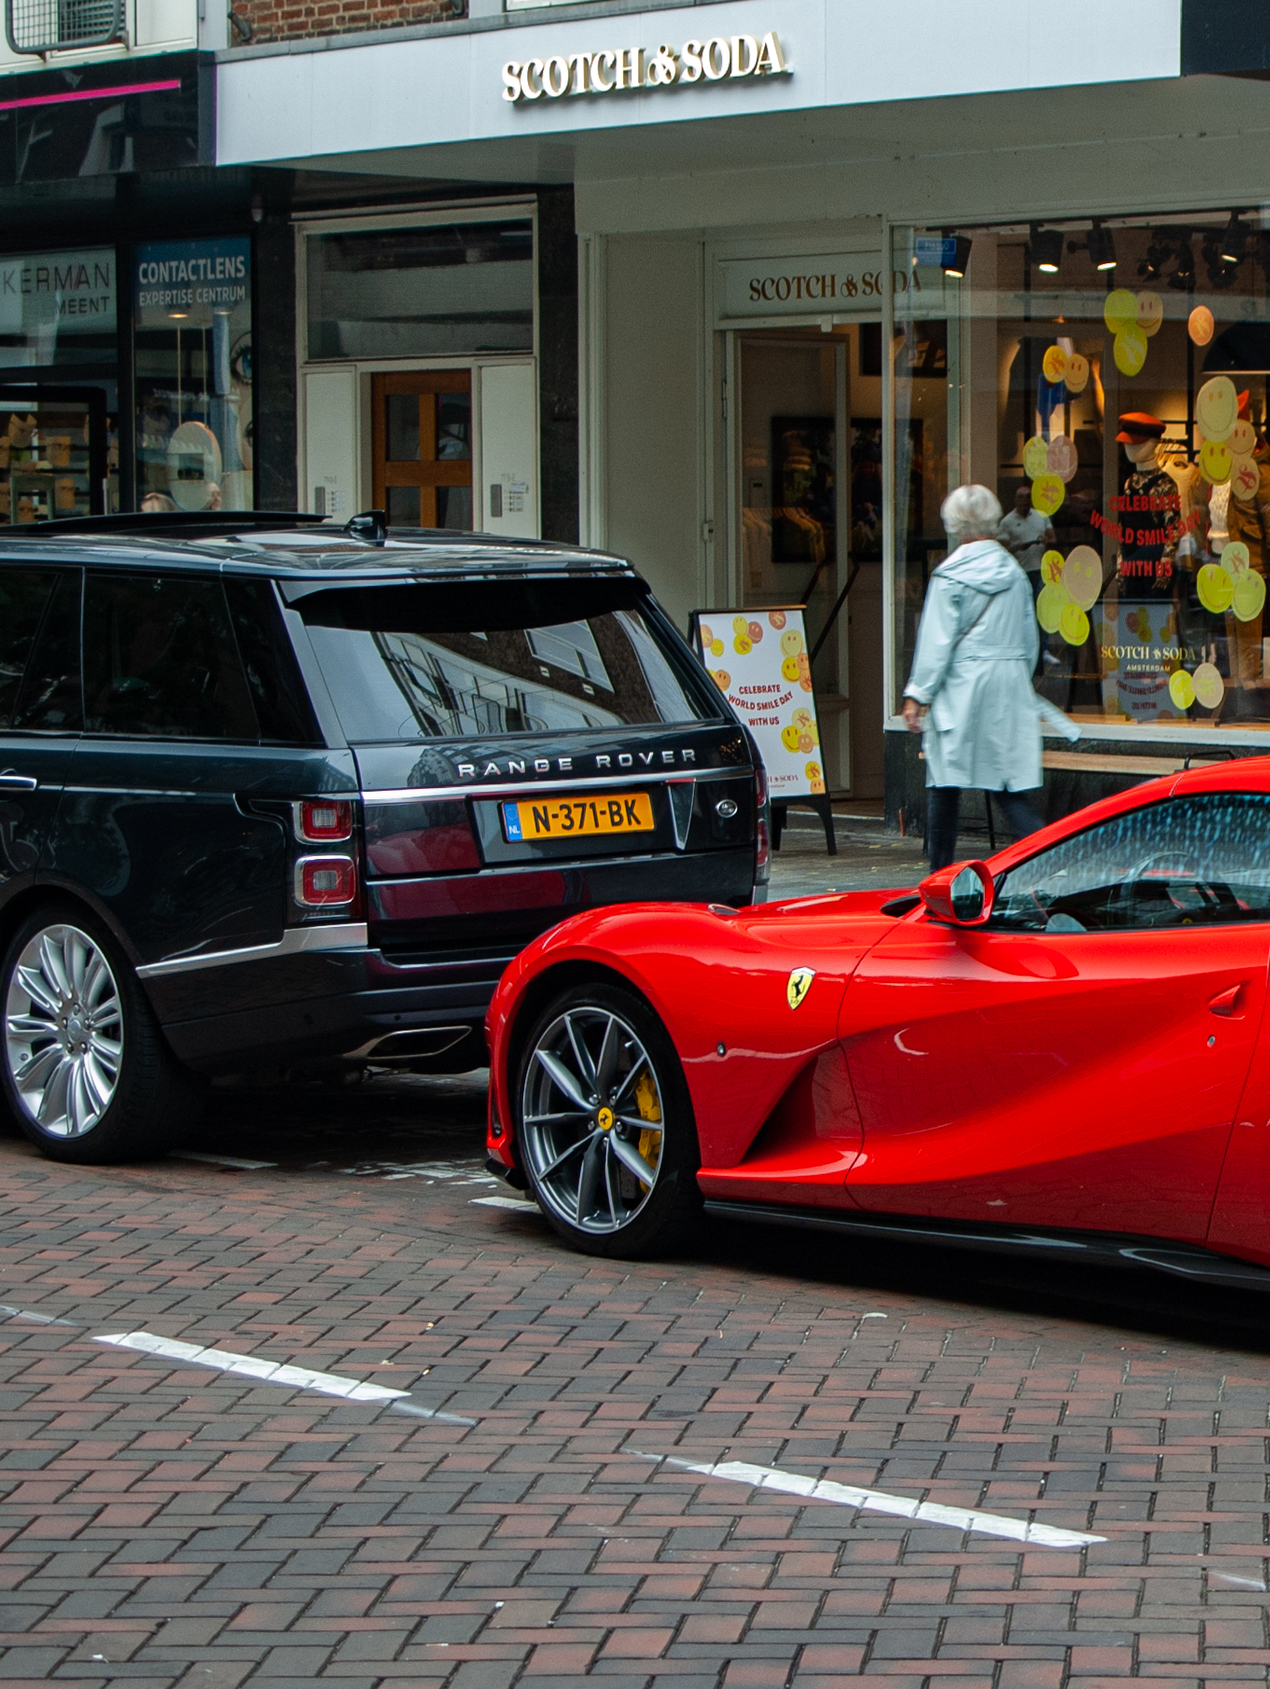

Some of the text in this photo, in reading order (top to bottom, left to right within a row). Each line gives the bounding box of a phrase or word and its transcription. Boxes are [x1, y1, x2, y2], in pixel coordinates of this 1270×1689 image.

[502, 31, 794, 102] SCOTCH & SODA
[138, 256, 246, 284] CONTACTLENS
[139, 286, 246, 306] EXPERTISE CENTRUM
[750, 273, 837, 302] SCOTCH
[840, 273, 859, 298] &
[1109, 494, 1181, 512] CELEBRATE
[1090, 510, 1201, 546] WORLD SMILE DAY
[1121, 560, 1173, 577] WITH US
[1101, 646, 1150, 659] SCOTCH
[1162, 647, 1195, 660] SODA
[739, 684, 781, 695] CELEBRATE
[728, 691, 794, 711] WORLD SMILE DAY
[748, 716, 780, 726] WITH US
[458, 749, 696, 778] RANGE ROVER
[532, 800, 642, 833] N-371-BK
[508, 826, 520, 834] NL
